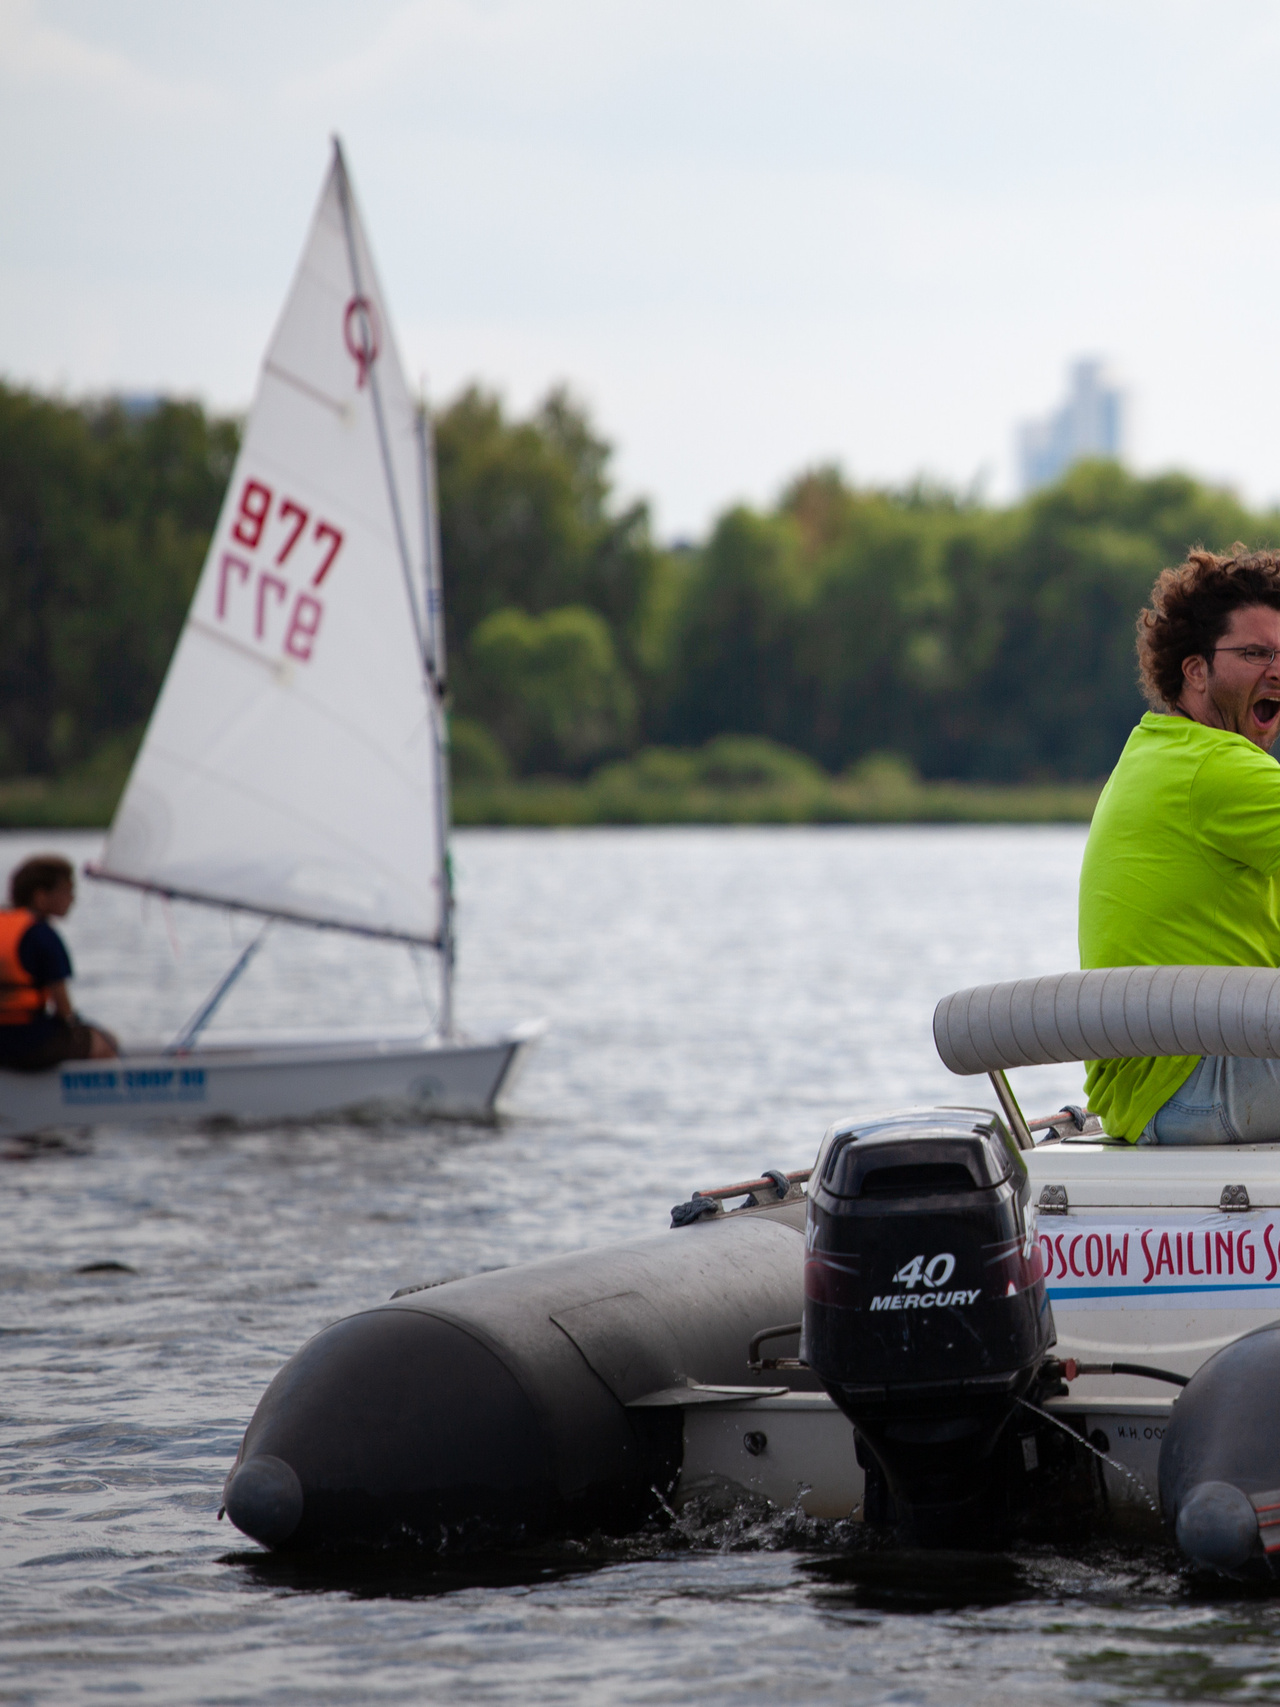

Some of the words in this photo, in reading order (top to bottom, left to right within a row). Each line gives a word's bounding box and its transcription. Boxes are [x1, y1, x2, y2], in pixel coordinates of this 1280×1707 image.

[231, 476, 344, 588] 977
[892, 1252, 956, 1289] 40
[1038, 1232, 1129, 1280] OSCOW
[1142, 1228, 1255, 1284] SAILING
[869, 1288, 981, 1312] MERCURY
